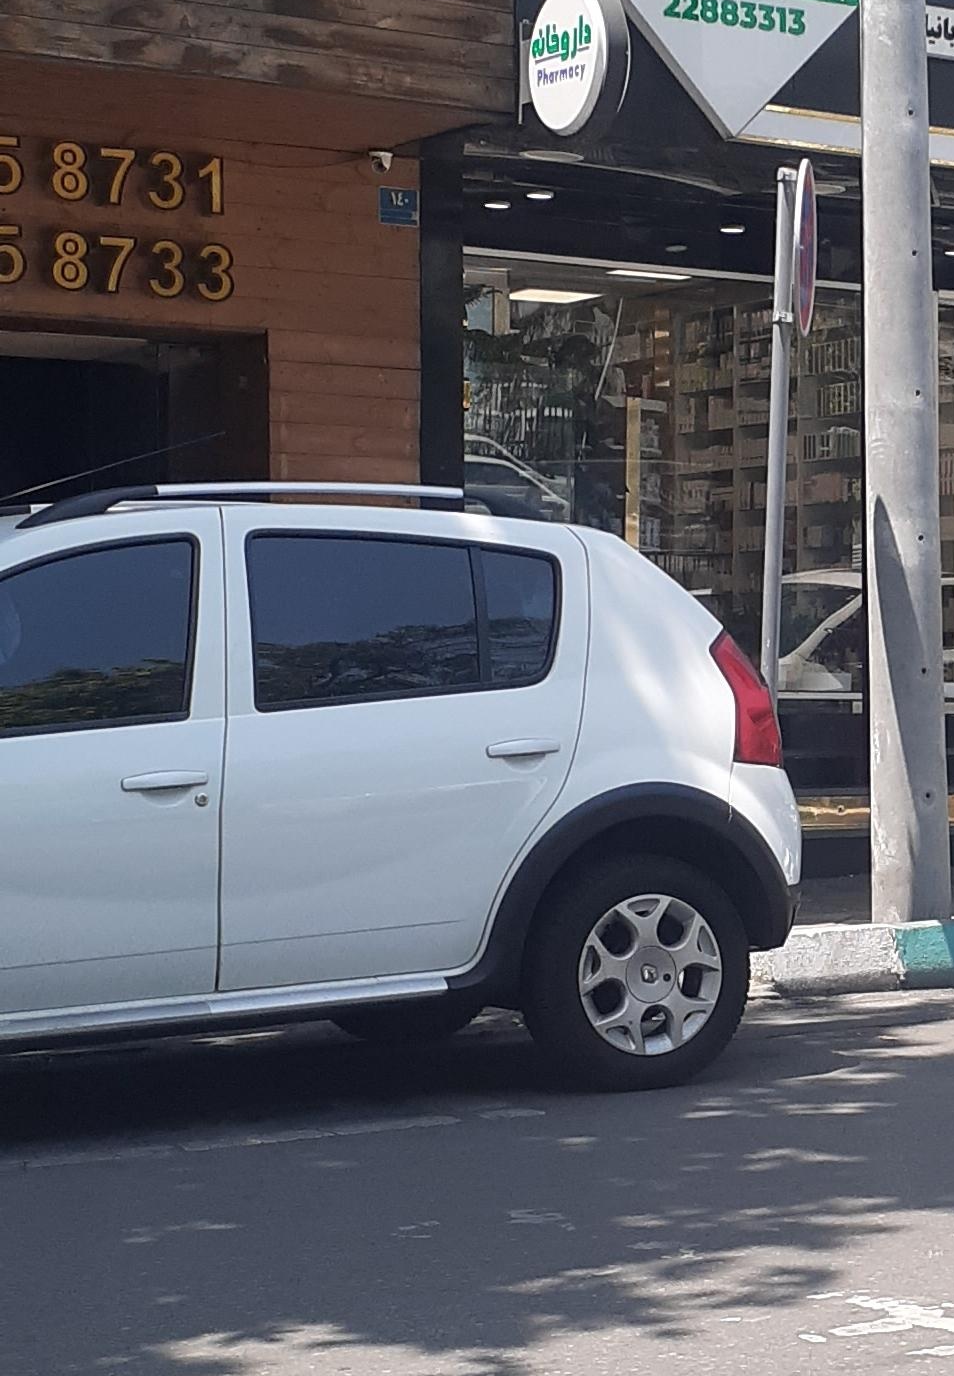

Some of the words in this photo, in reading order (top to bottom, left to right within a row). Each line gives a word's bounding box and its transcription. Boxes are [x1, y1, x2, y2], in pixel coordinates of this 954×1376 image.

[531, 14, 592, 62] داروخانه
[536, 63, 587, 88] Pharmacy
[52, 141, 225, 214] 8731
[52, 231, 234, 302] 8733
